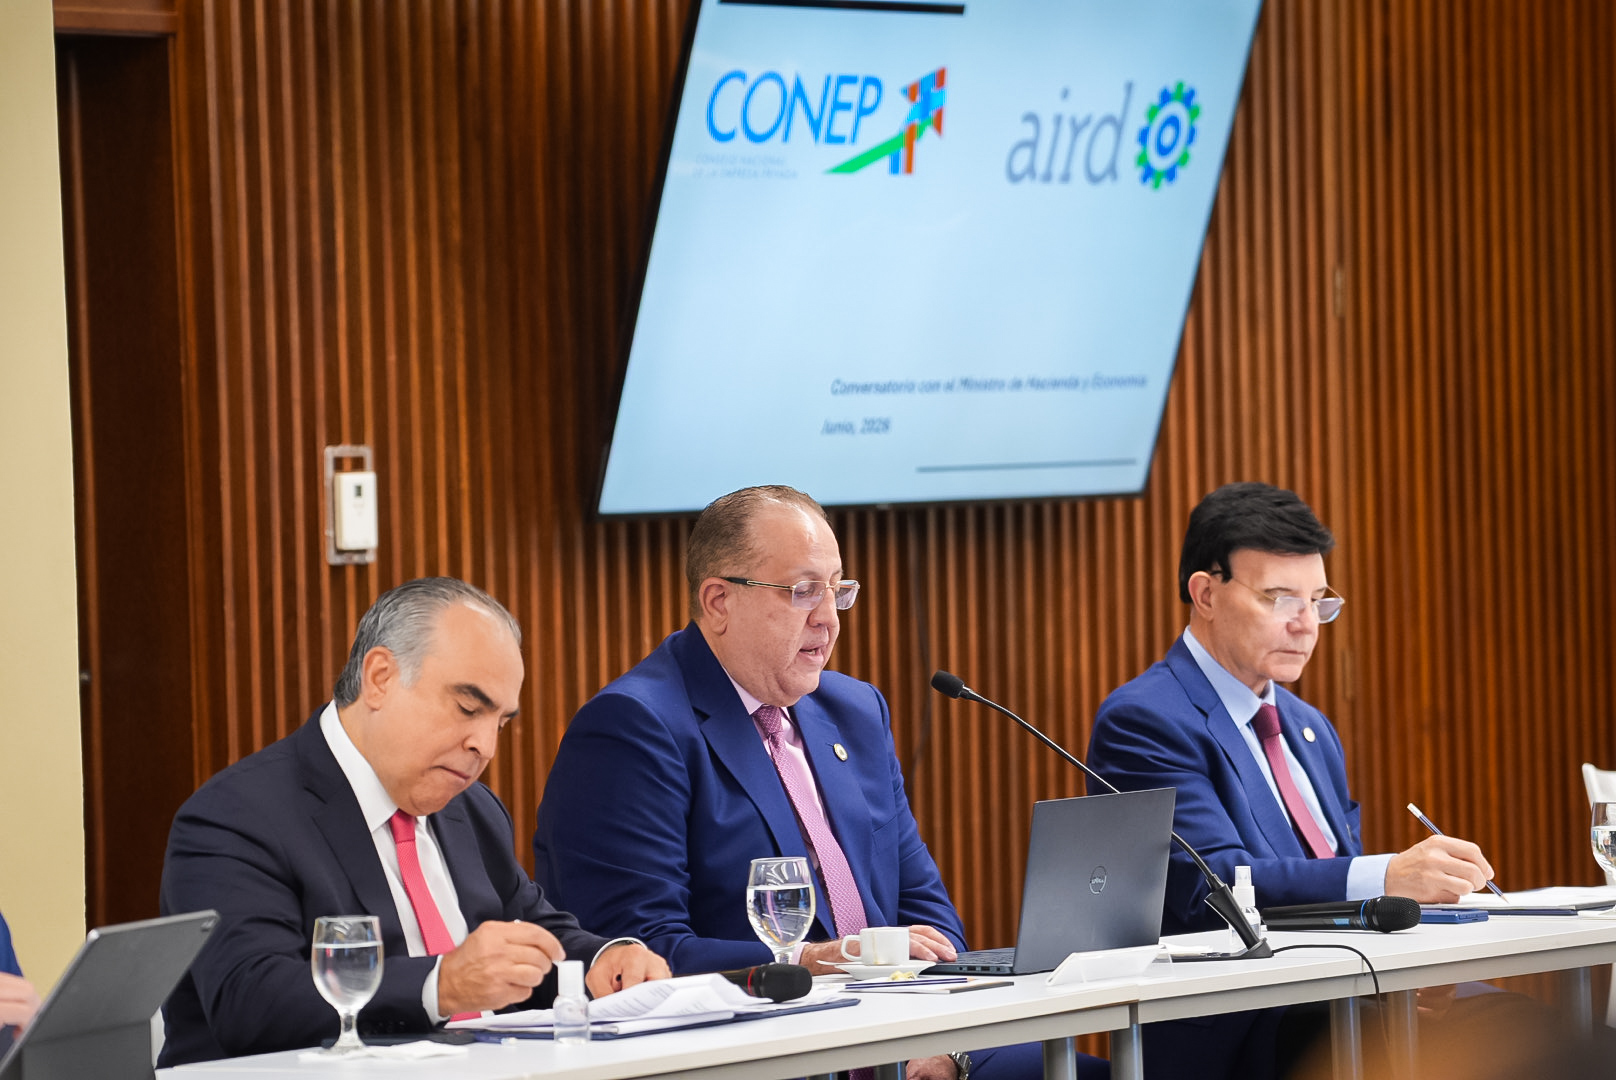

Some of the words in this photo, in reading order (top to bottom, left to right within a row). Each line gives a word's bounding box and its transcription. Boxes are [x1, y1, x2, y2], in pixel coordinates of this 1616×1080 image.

[706, 69, 883, 144] CONEP
[1005, 80, 1134, 184] aird
[831, 378, 915, 395] Conversatorio
[917, 381, 940, 394] con
[943, 378, 954, 392] el
[959, 376, 1005, 392] Ministro
